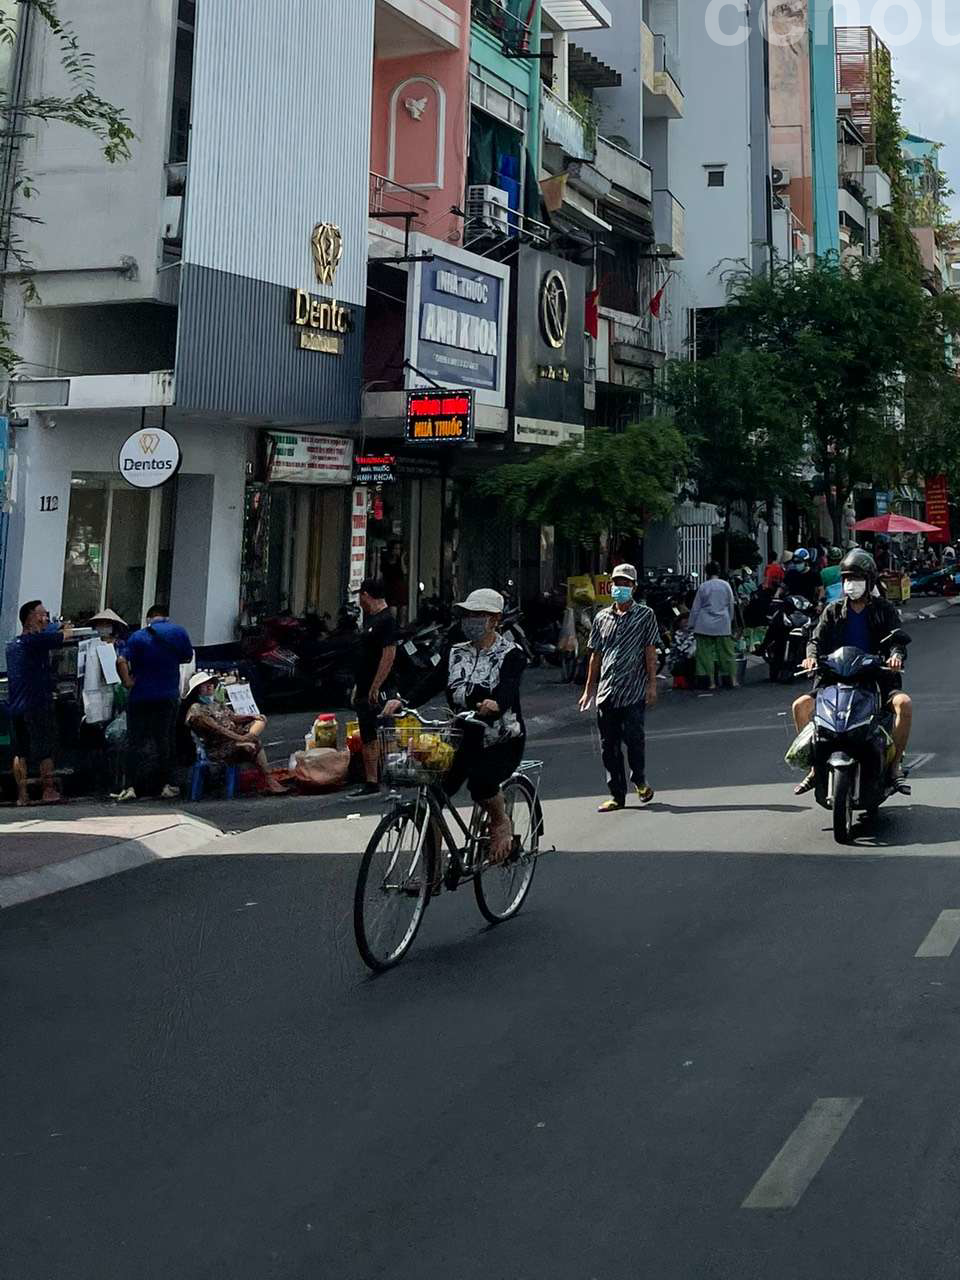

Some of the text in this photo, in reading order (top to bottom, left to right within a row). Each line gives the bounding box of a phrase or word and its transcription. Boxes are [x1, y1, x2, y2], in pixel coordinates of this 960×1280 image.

[295, 287, 352, 333] Dento
[414, 415, 463, 437] NHÀ THUỐC
[123, 458, 173, 471] Dentos
[39, 495, 59, 512] 112
